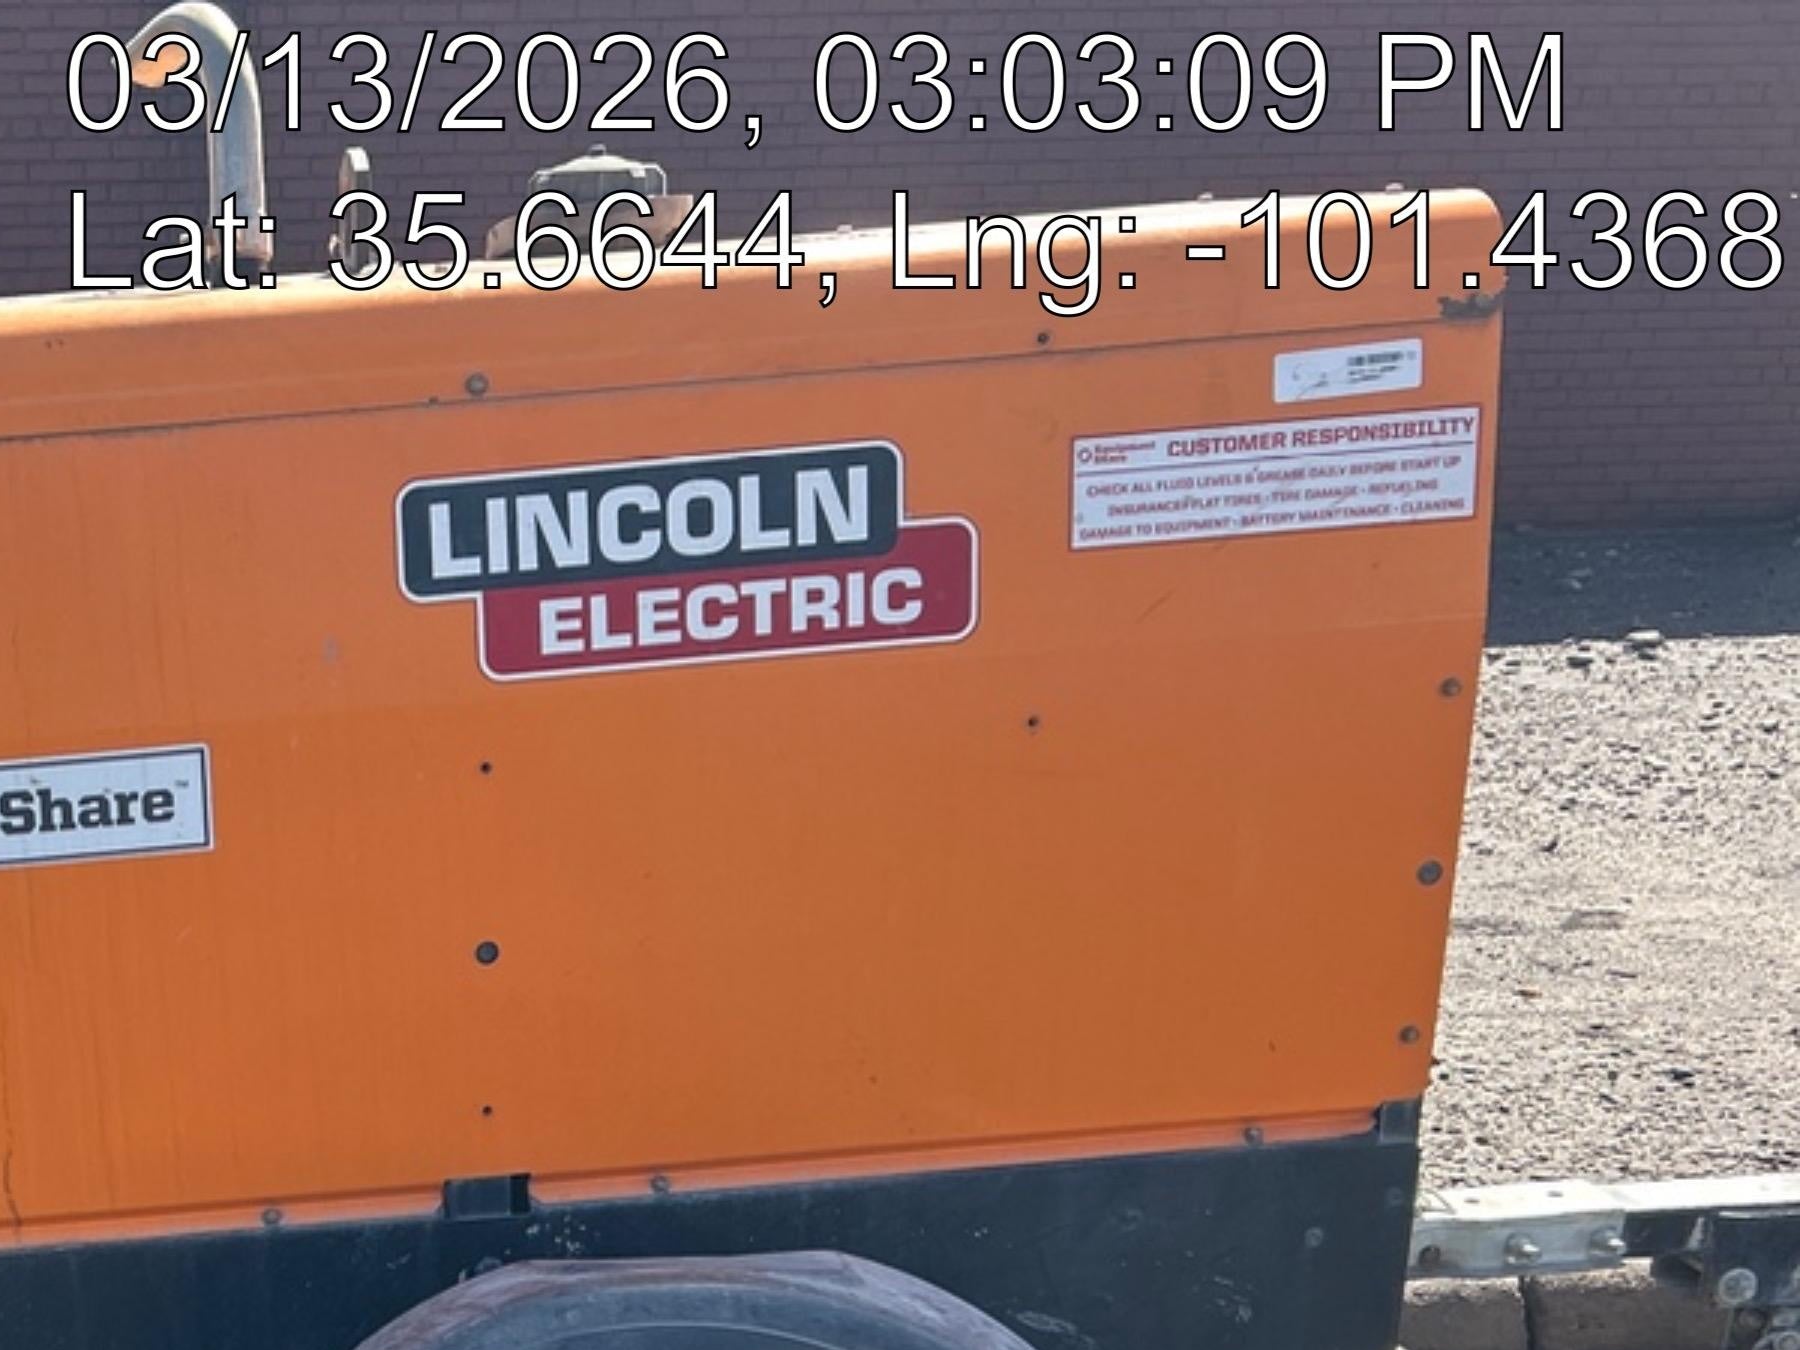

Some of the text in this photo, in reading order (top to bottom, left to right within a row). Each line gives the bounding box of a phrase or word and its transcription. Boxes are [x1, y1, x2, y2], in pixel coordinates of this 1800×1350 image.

[1167, 416, 1474, 457] CUSTOMER RESPONSIBILITY
[1086, 483, 1128, 497] CHECK
[1131, 481, 1152, 494] ALL
[1350, 461, 1395, 476] BEFORE
[1401, 457, 1441, 471] START
[1443, 455, 1461, 468] UP
[428, 464, 869, 580] LINCOLN
[1136, 524, 1151, 536] TO
[539, 566, 923, 656] ELECTRIC
